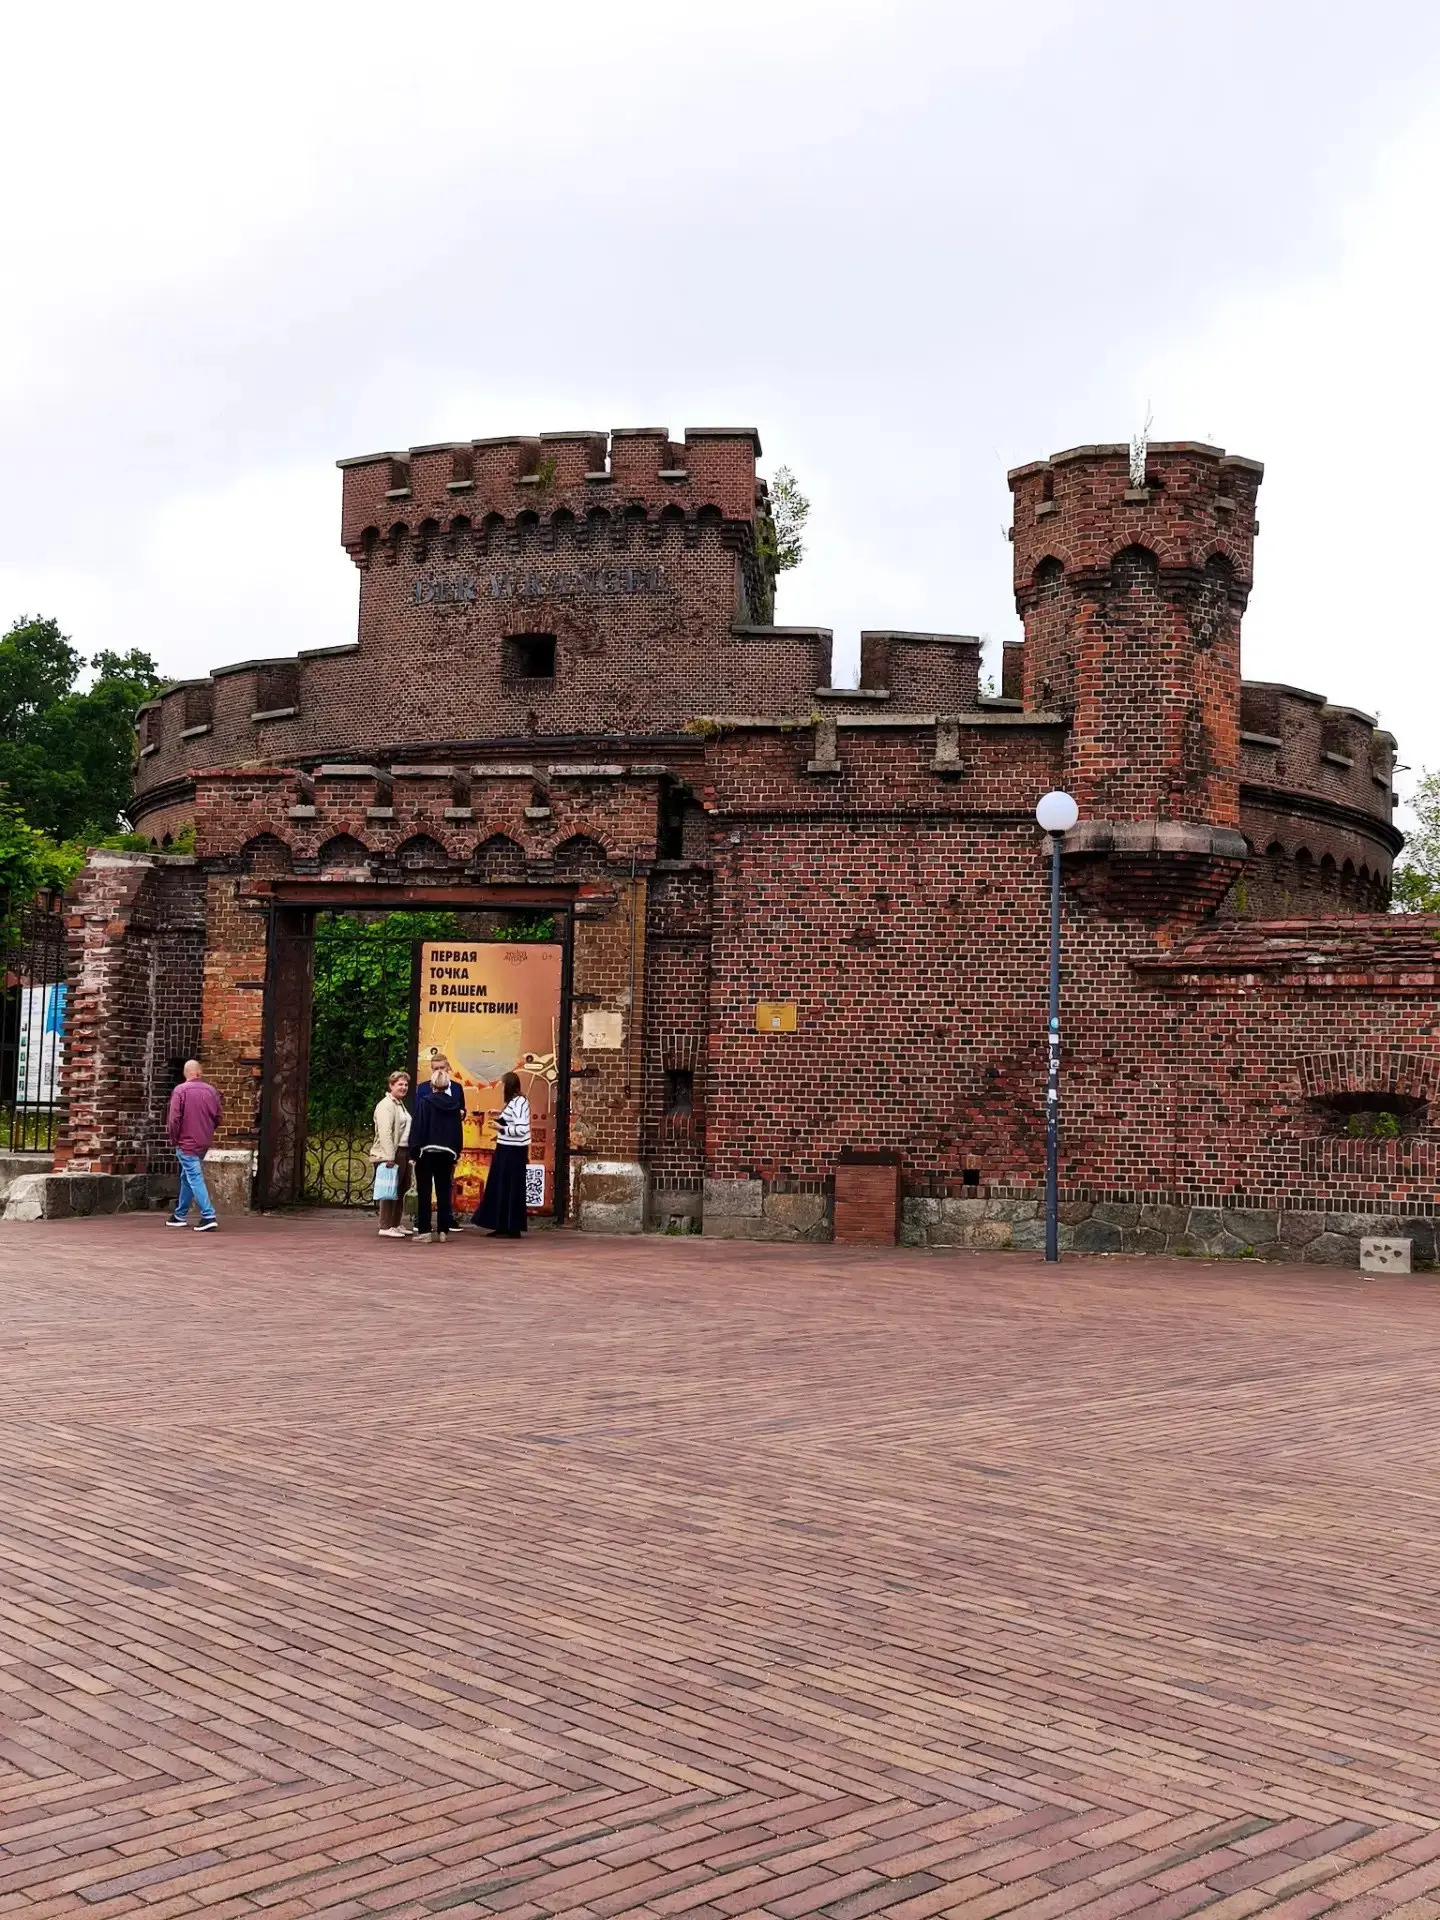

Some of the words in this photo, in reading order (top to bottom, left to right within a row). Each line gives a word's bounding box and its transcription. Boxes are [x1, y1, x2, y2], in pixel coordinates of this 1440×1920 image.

[414, 577, 477, 604] DER
[488, 567, 669, 598] WRANGEL
[431, 950, 477, 962] ПЕРВАЯ
[542, 952, 553, 961] 0+
[430, 967, 469, 979] ТОЧКА
[429, 984, 438, 996] В
[441, 984, 487, 996] ВАШЕМ
[429, 1001, 519, 1014] ПУТЕШЕСТВИИ!
